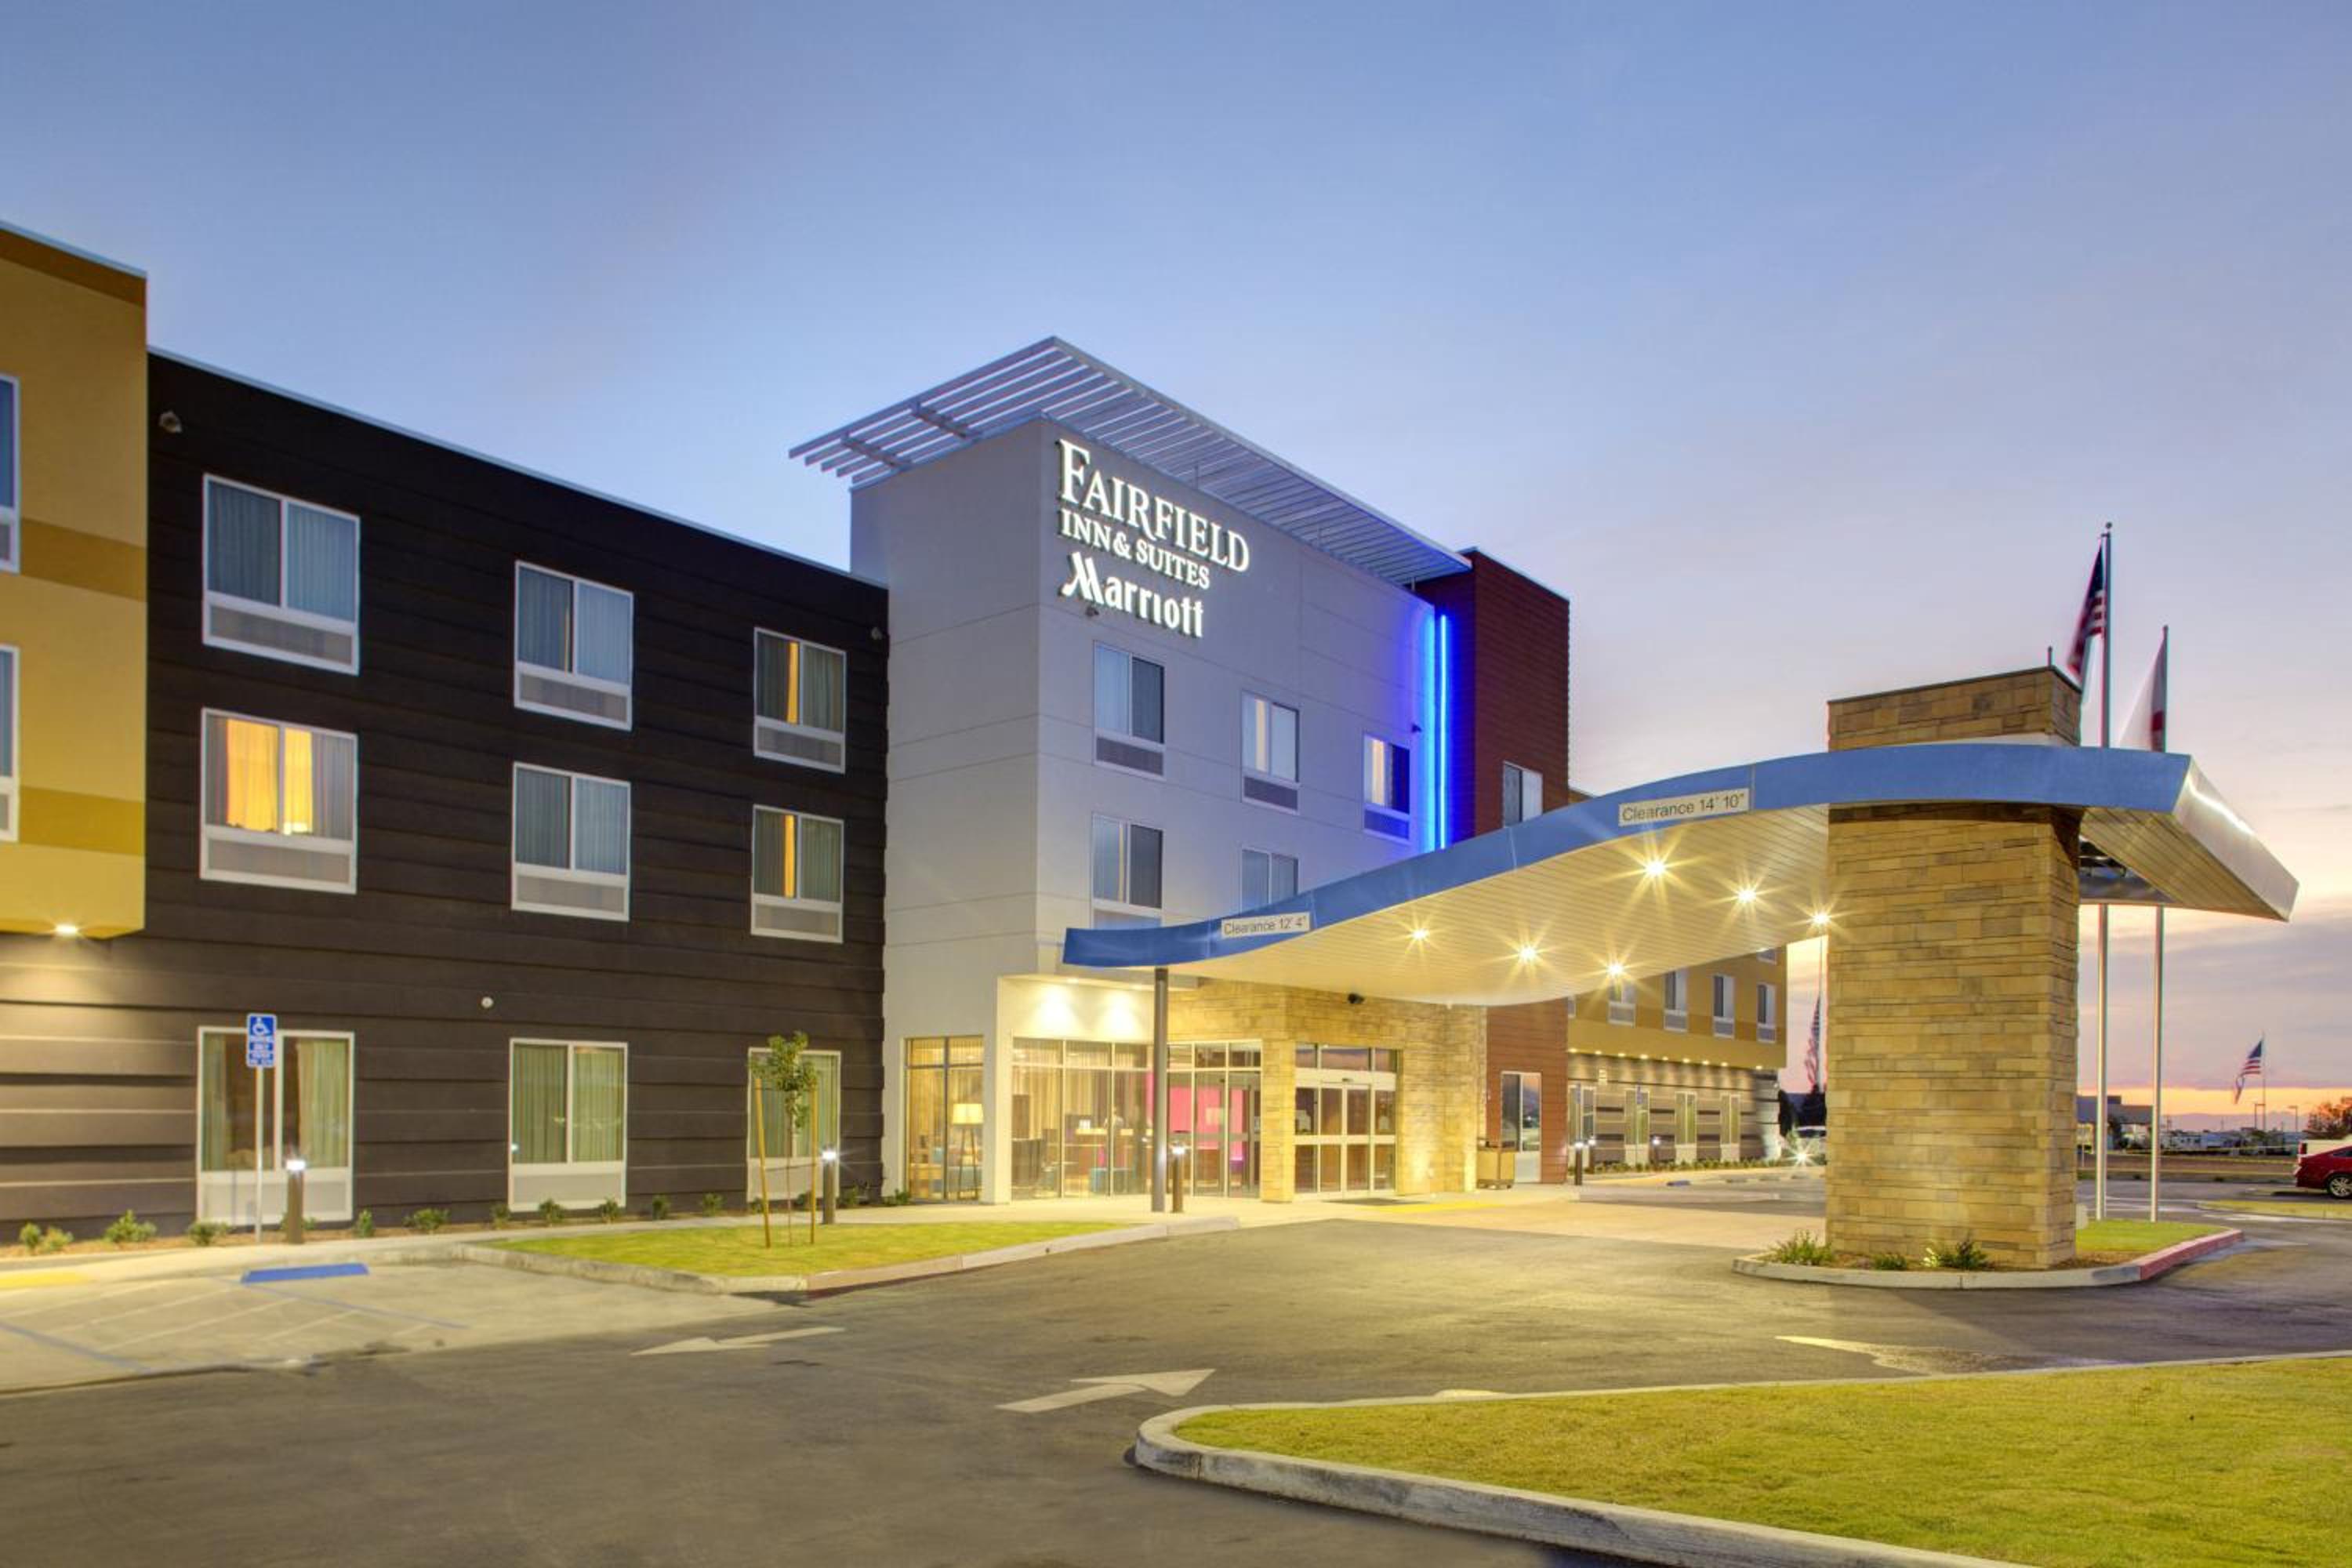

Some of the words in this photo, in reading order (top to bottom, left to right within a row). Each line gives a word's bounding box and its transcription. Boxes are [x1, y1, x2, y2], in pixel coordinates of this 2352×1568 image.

[1059, 438, 1250, 572] FAIRFIELD
[1136, 538, 1210, 590] SUITES
[1061, 551, 1204, 638] Marriott
[1622, 802, 1695, 822] Clearance
[1224, 920, 1276, 935] Clearance
